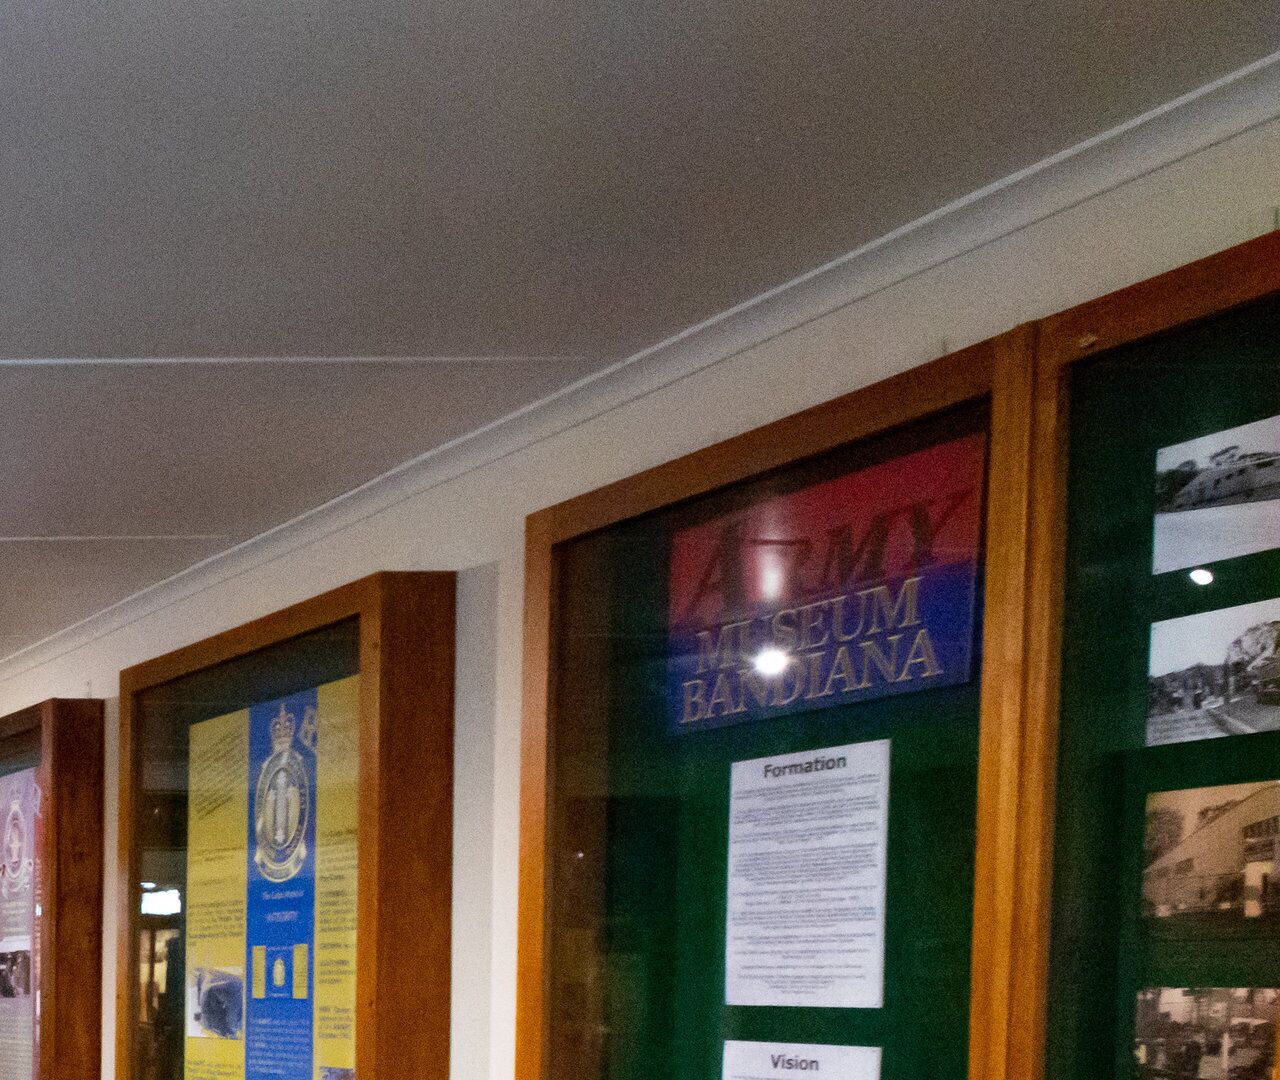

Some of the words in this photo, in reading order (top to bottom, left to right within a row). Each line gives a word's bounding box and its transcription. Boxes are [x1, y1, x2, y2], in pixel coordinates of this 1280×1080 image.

[695, 576, 924, 674] MUSEUM
[680, 629, 943, 724] BANDIANA
[764, 756, 847, 778] Formation
[771, 1053, 819, 1071] Vision
